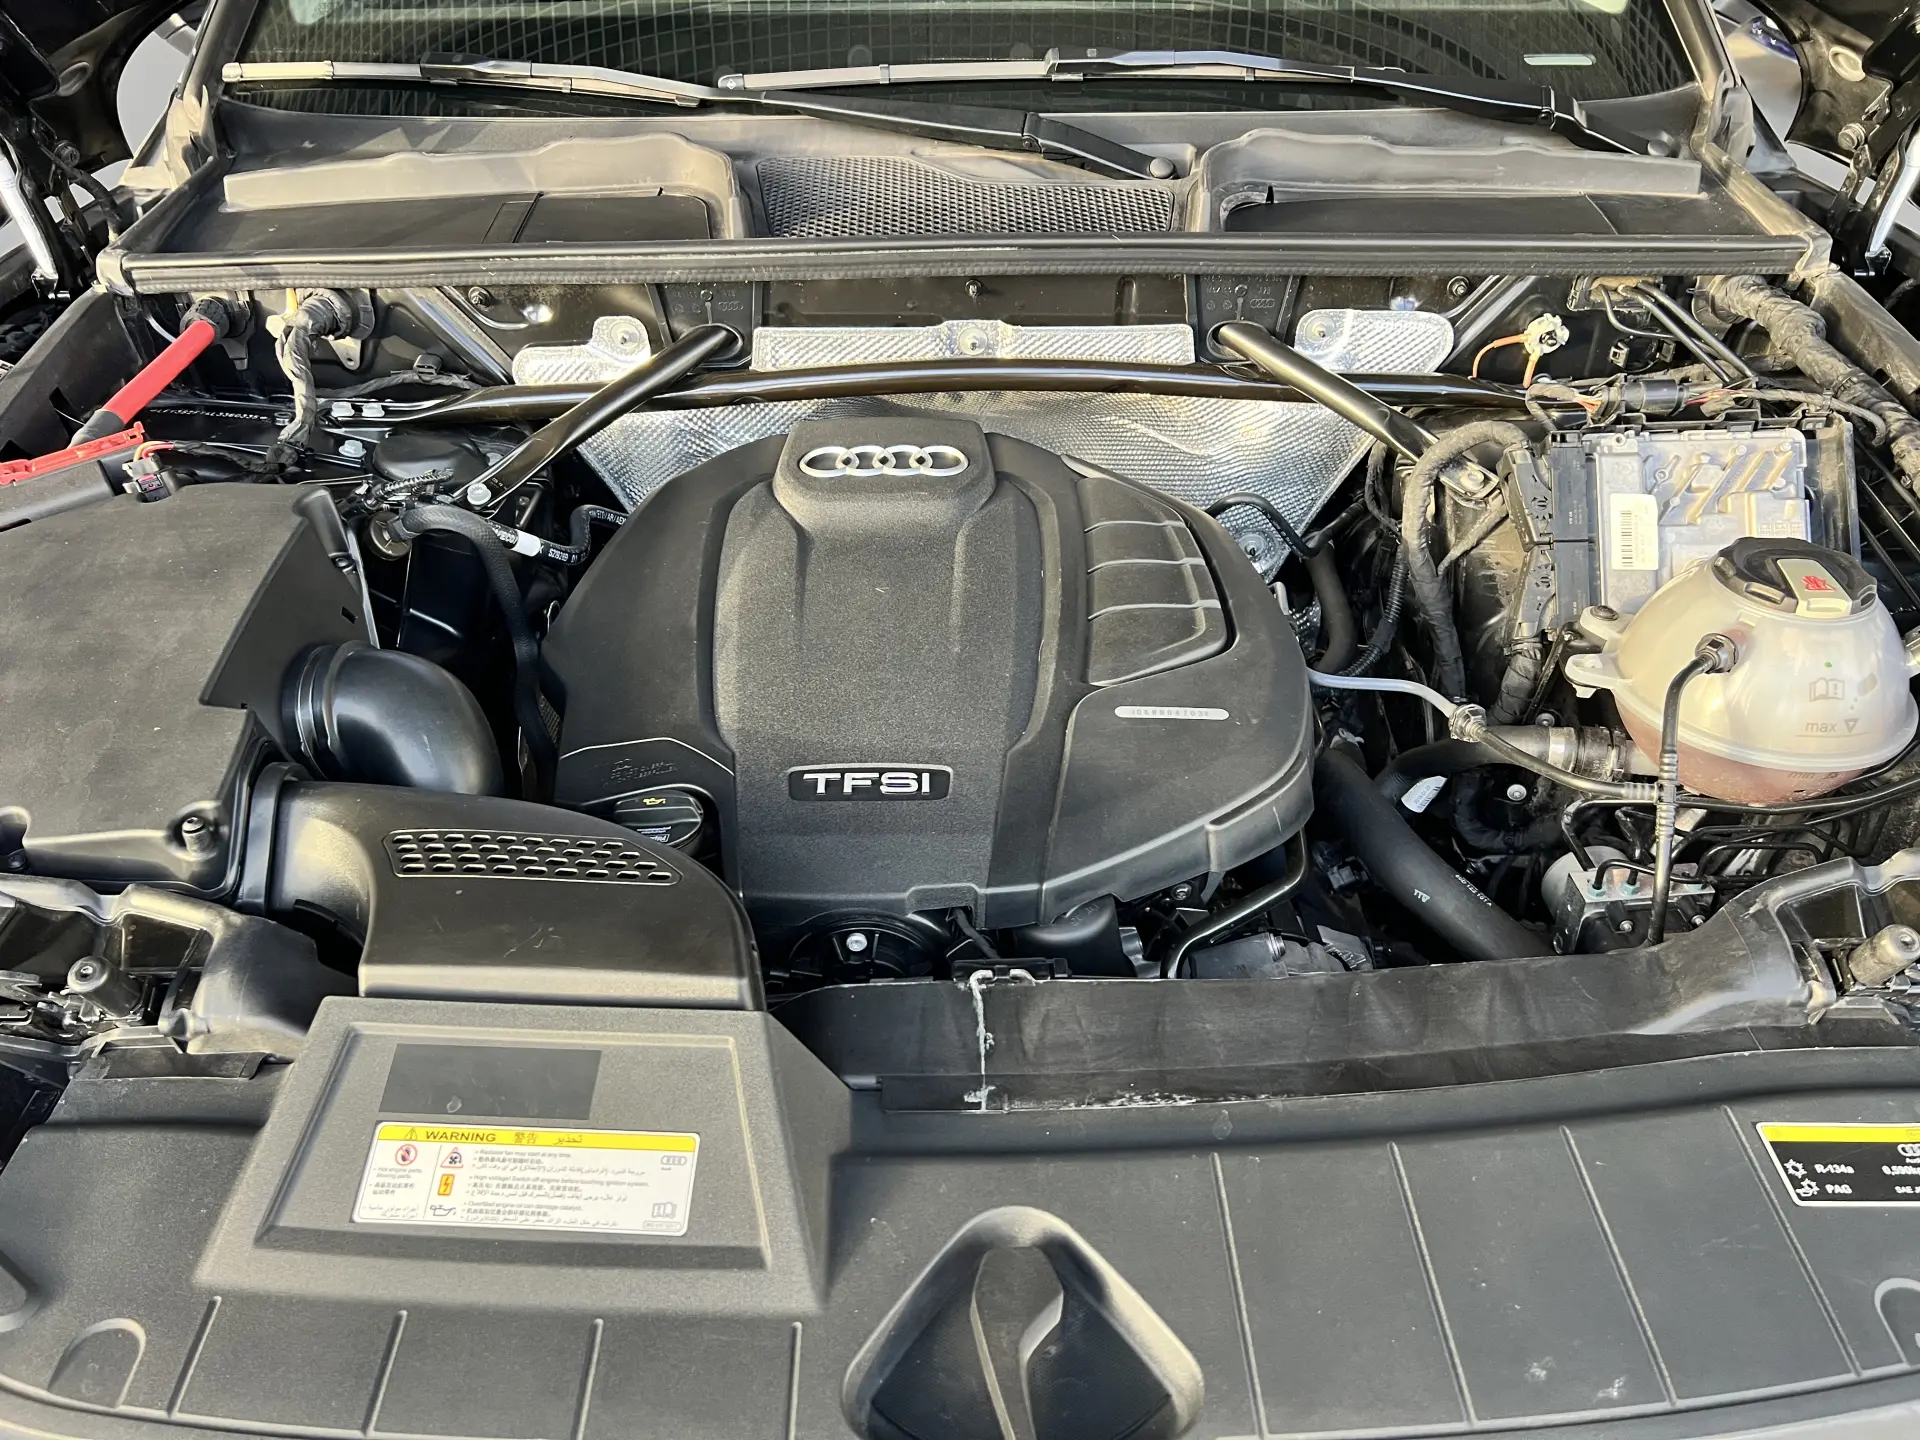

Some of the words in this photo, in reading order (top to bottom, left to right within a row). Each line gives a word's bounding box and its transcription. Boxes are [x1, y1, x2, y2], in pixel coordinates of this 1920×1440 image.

[1805, 722, 1838, 733] max
[803, 772, 930, 795] TFSI
[425, 1131, 497, 1142] WARNING
[514, 1132, 537, 1144] 警告
[1814, 1163, 1855, 1174] R-134a
[1824, 1183, 1853, 1194] PAG
